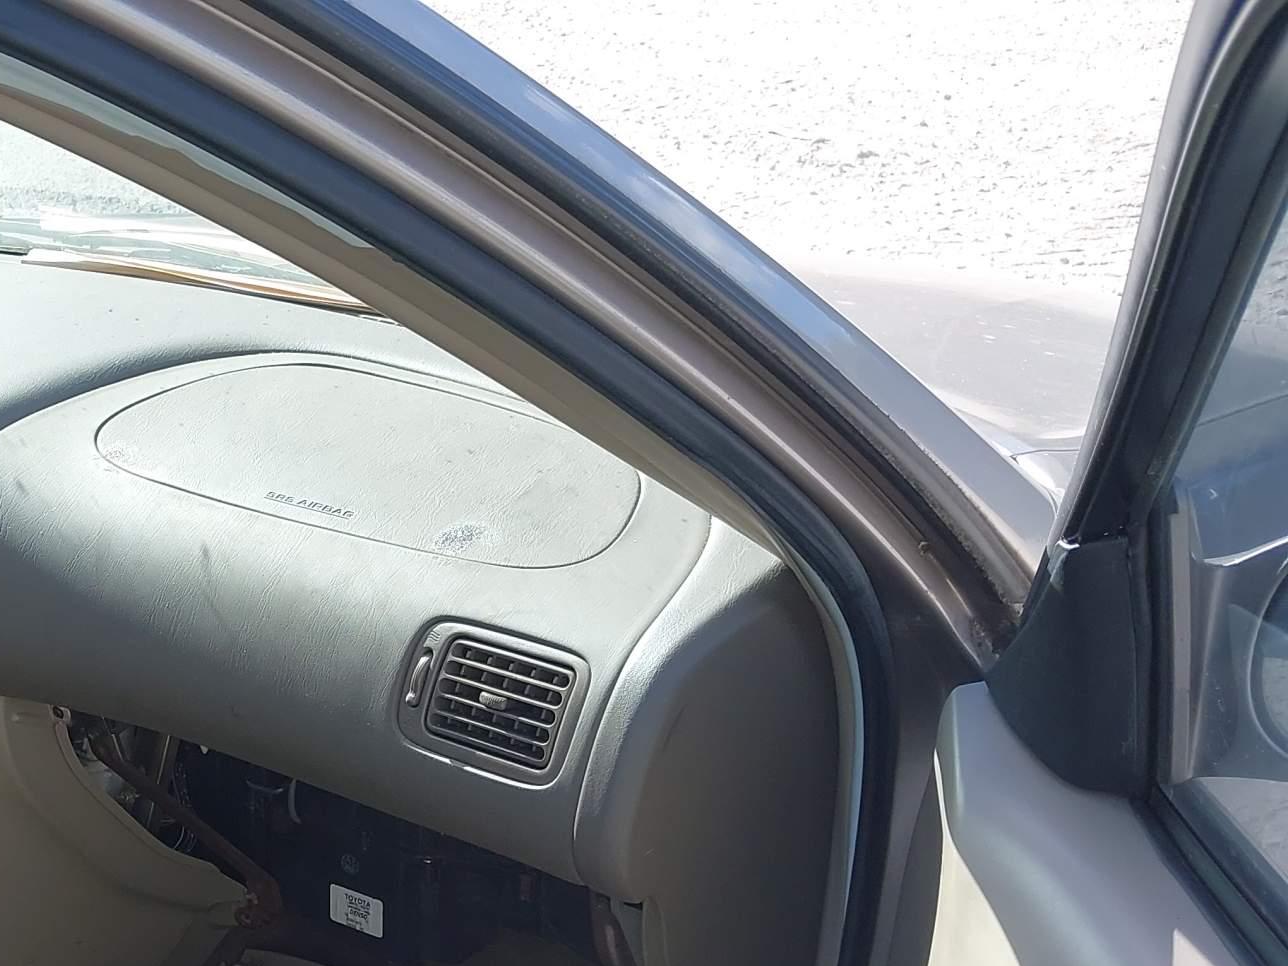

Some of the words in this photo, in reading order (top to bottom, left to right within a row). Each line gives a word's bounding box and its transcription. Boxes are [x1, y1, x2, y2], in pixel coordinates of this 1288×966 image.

[266, 491, 296, 503] SRS
[297, 499, 355, 518] AIRBAG
[344, 893, 371, 907] TOYOTA
[349, 909, 368, 921] DENSO
